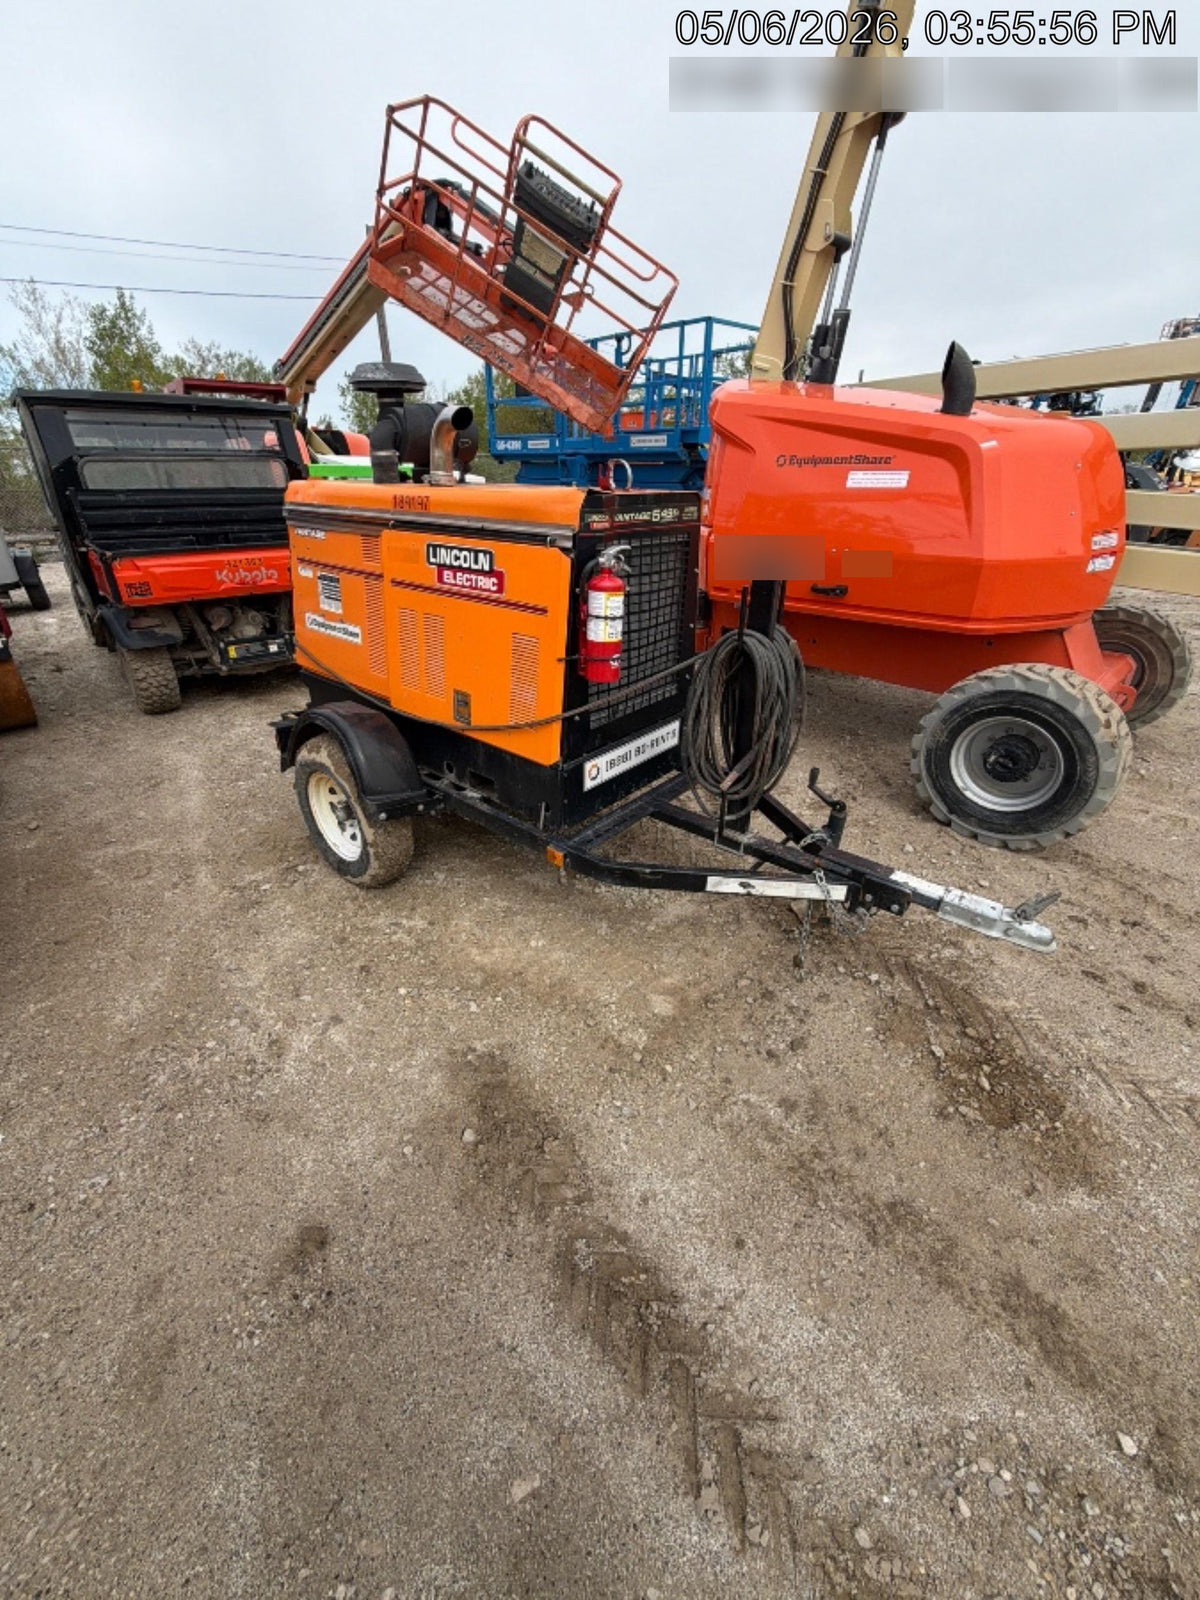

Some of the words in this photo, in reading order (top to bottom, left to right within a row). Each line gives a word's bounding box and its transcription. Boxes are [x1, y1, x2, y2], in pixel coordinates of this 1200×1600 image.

[789, 454, 893, 467] EquipmentShare
[429, 546, 490, 571] LINCOLN
[215, 568, 278, 583] Kubota
[443, 570, 498, 591] ELECTRIC
